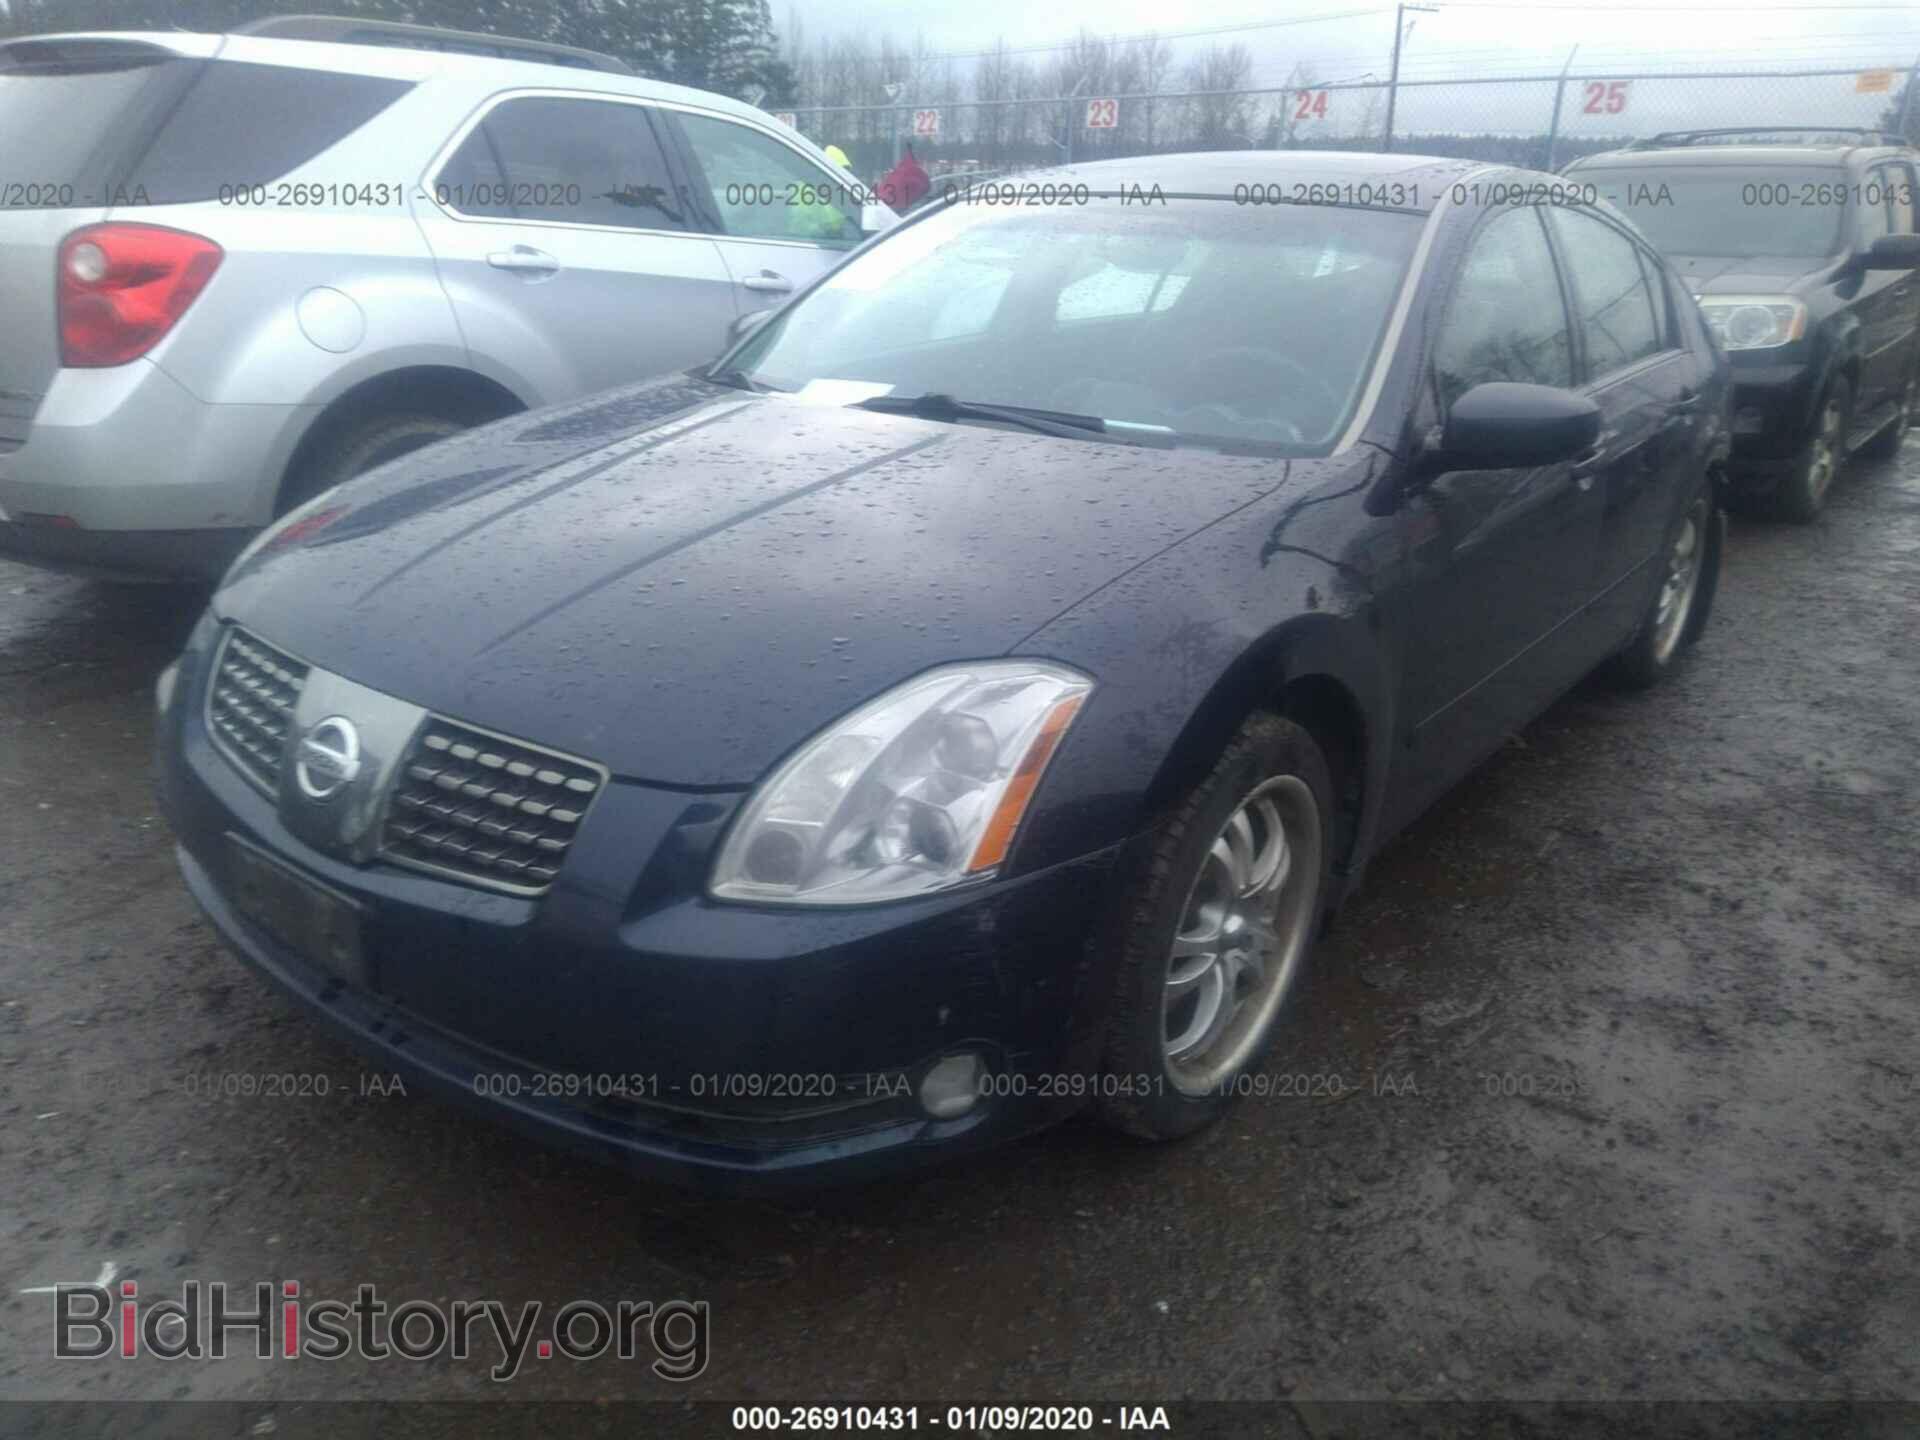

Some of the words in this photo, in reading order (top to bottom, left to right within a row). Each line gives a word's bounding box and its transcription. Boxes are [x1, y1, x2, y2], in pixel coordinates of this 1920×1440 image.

[1295, 91, 1328, 119] 24
[1584, 81, 1628, 114] 25
[916, 111, 937, 132] 22
[1090, 101, 1116, 126] 23
